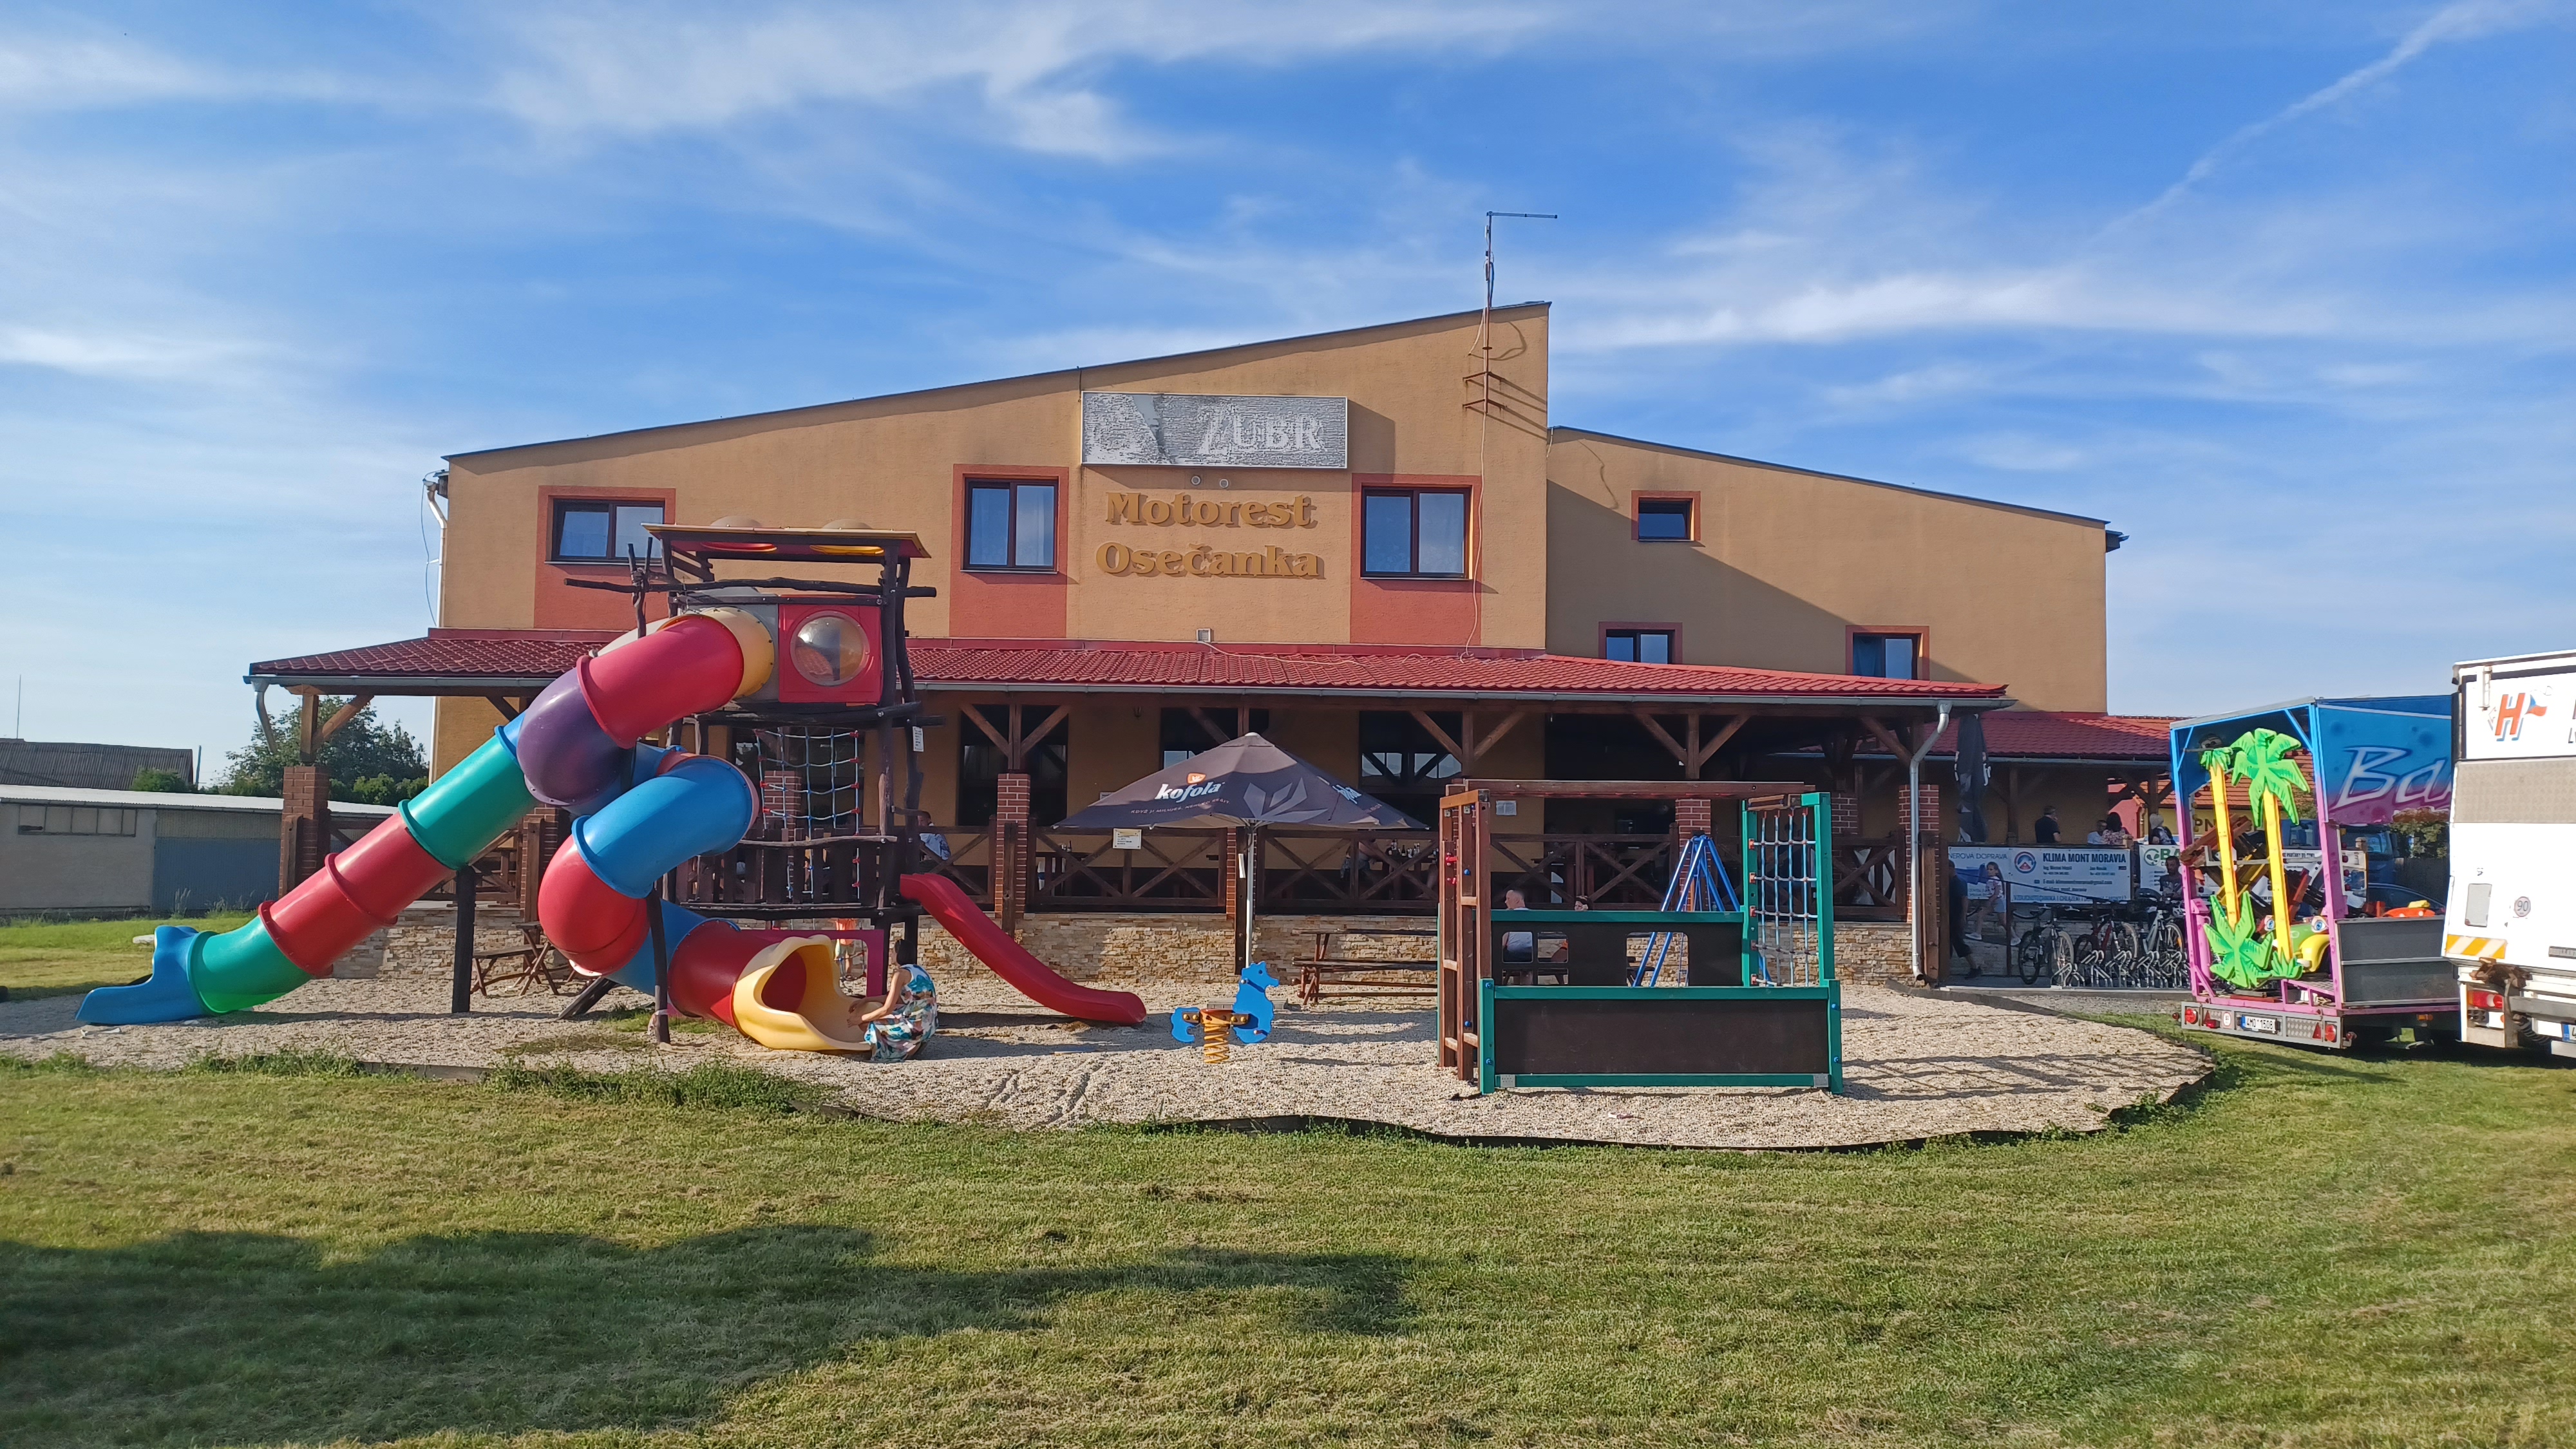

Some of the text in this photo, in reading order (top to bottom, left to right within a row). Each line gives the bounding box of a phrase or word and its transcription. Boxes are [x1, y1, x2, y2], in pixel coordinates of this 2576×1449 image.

[1106, 492, 1312, 526] Motorest
[1096, 542, 1319, 577] Osečanka
[1155, 781, 1222, 803] kofola
[2329, 746, 2451, 811] Ba
[2043, 853, 2126, 863] KLIMA MONT MORAVIA
[2517, 900, 2529, 912] 90
